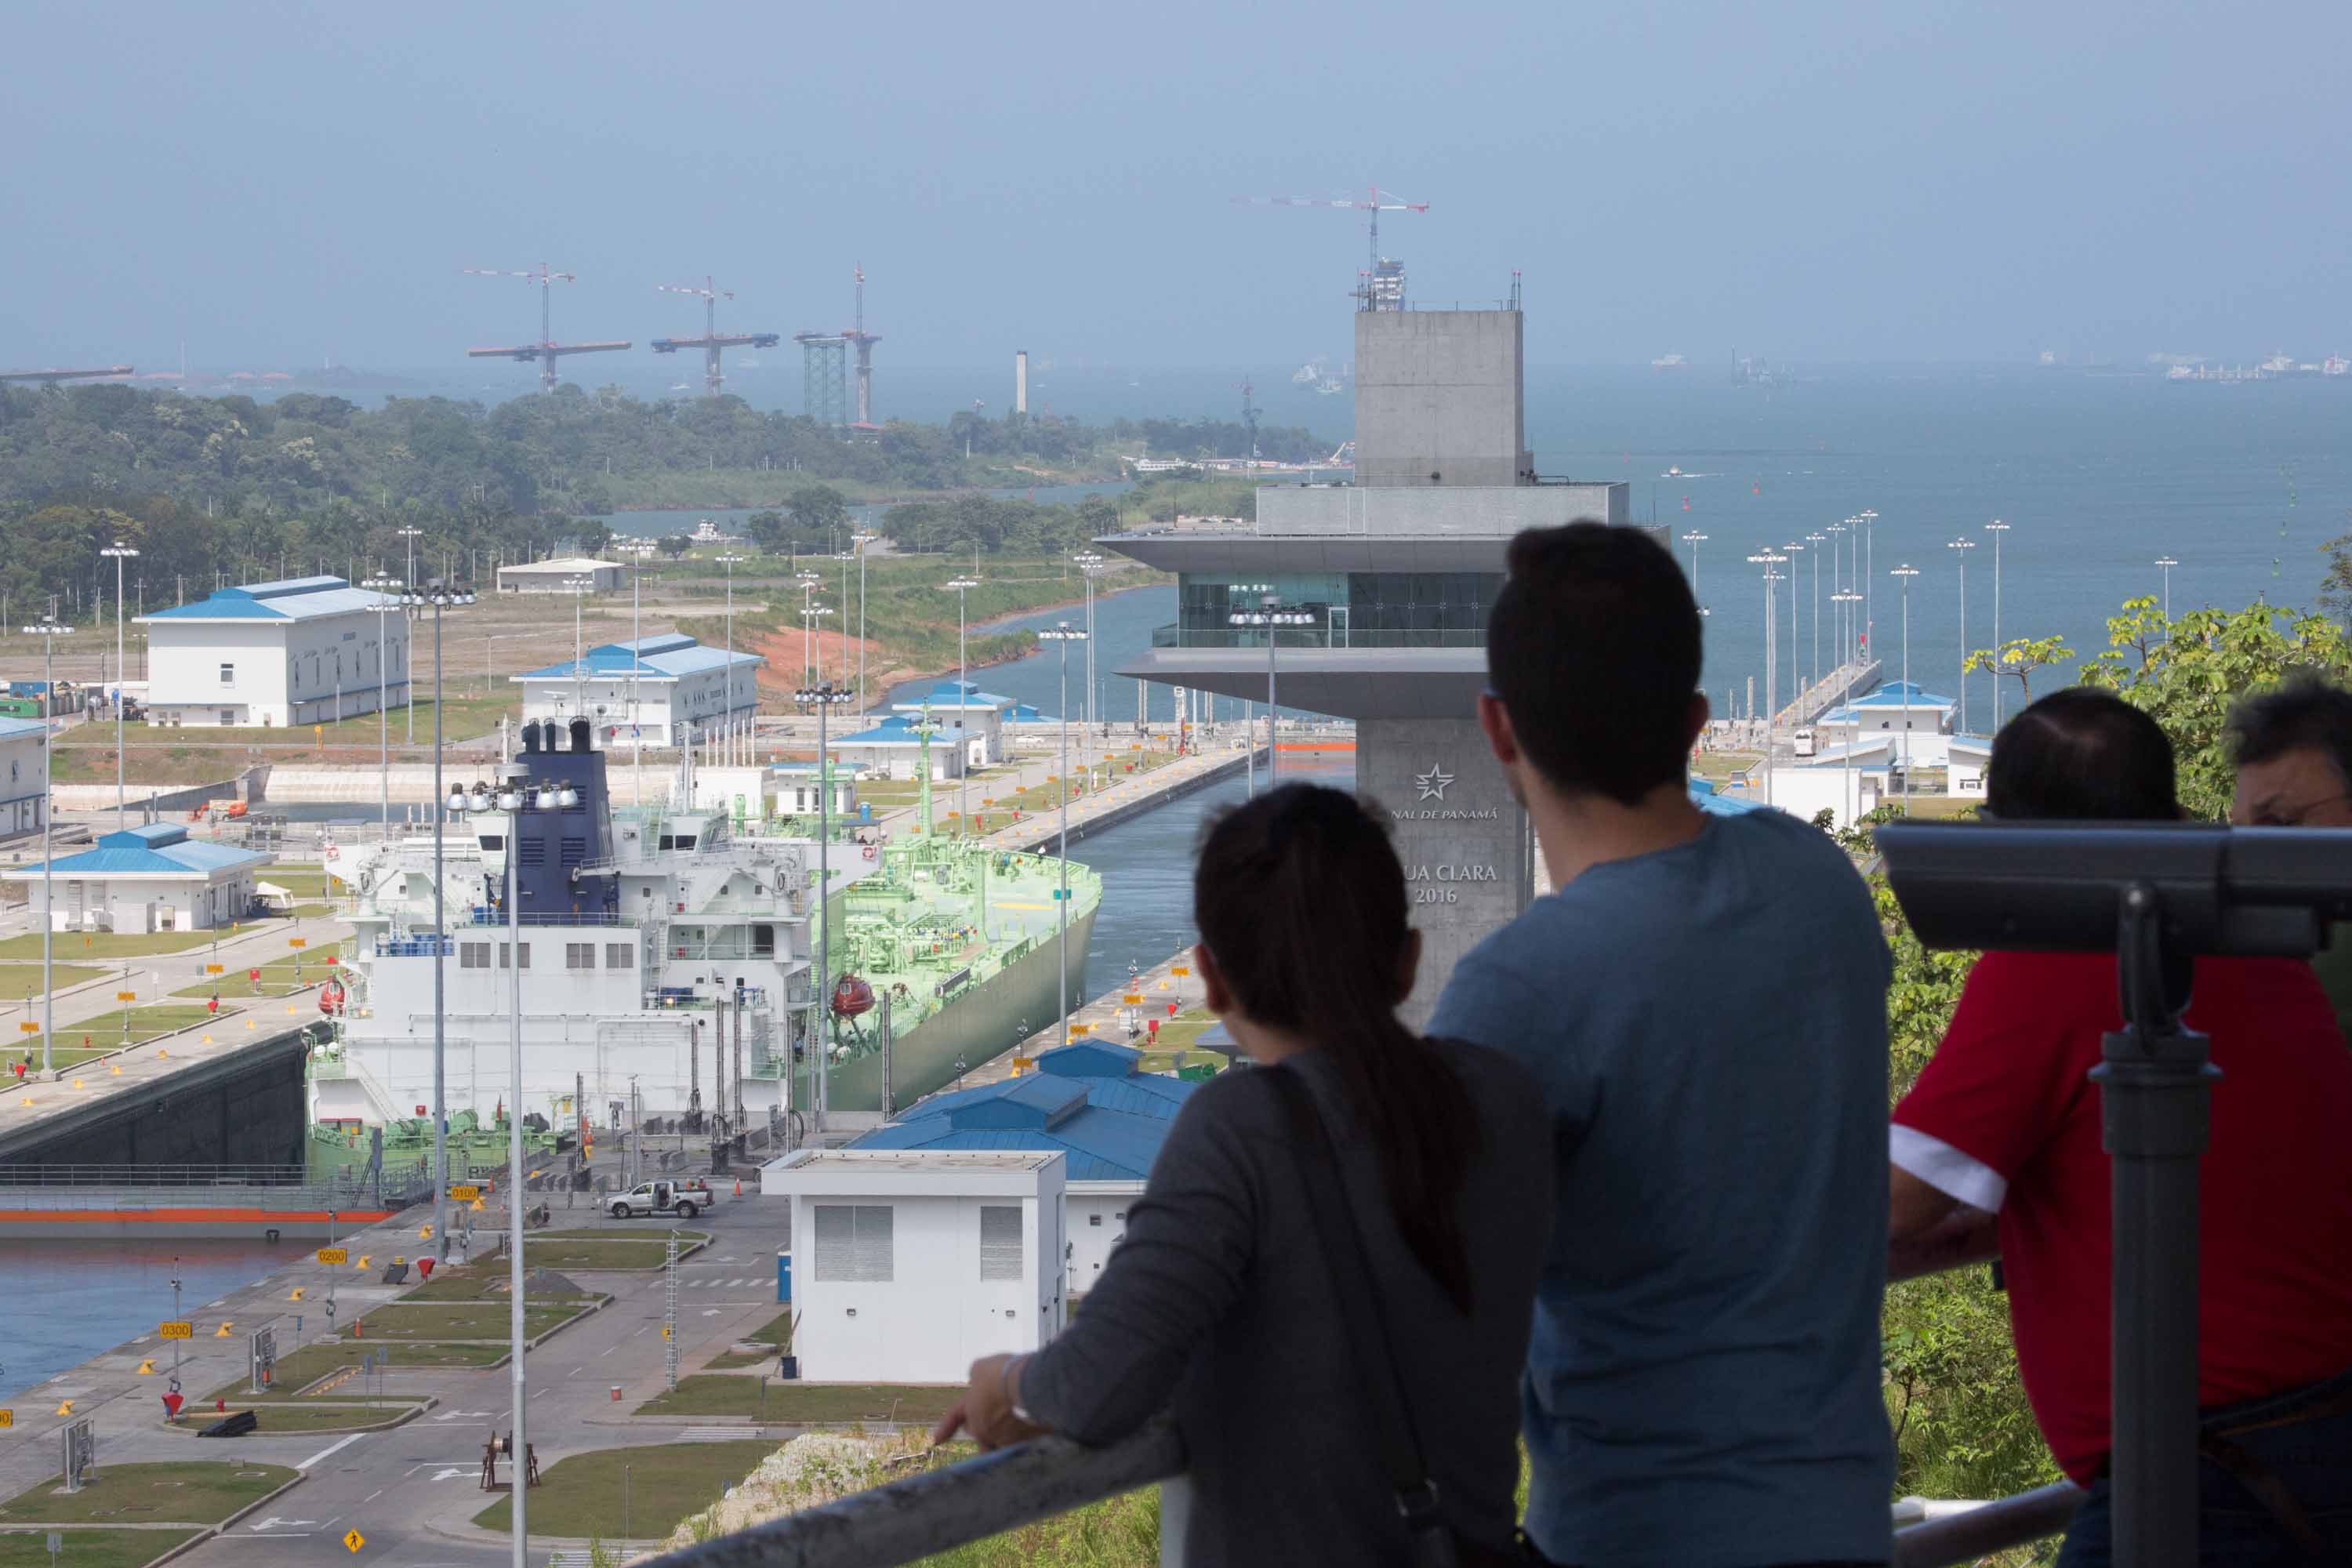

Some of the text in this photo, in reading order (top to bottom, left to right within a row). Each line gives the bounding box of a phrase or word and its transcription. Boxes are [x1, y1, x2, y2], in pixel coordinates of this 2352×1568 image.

[1391, 807, 1498, 819] NAL DE PANAMÁ
[1404, 865, 1497, 880] UA CLARA
[1415, 888, 1457, 903] 2016
[452, 1188, 477, 1198] 0100
[319, 1250, 345, 1261] 0200
[162, 1324, 189, 1335] 0300
